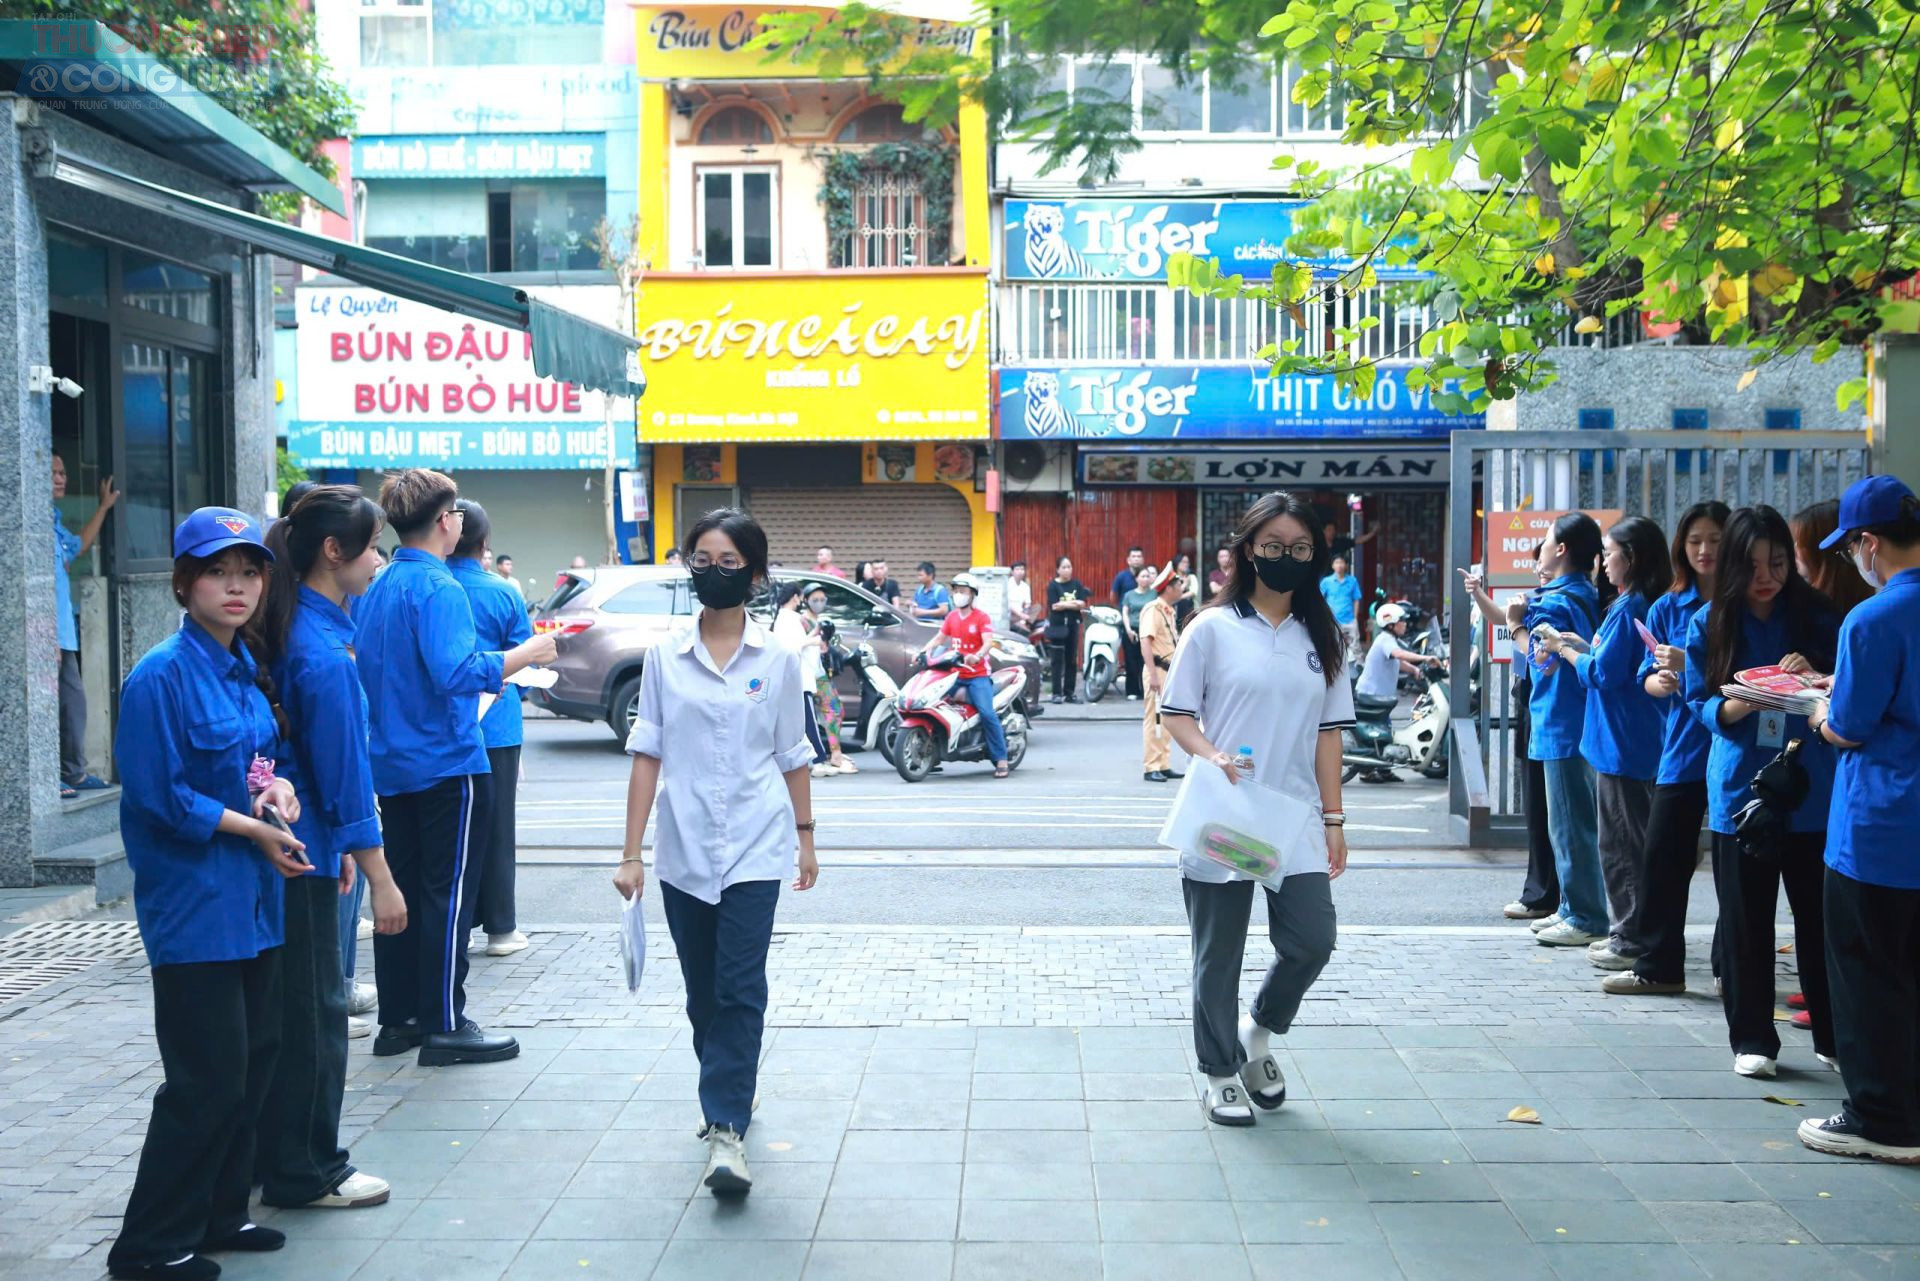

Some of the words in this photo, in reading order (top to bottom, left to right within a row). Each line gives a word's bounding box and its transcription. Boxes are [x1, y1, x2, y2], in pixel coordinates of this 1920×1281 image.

[650, 11, 710, 49] Bún
[1074, 203, 1219, 276] Tiger
[340, 296, 398, 317] Quyên
[331, 323, 412, 362] BÚN
[425, 323, 508, 370] ĐẬU
[355, 376, 429, 413] BÚN
[443, 374, 496, 413] BÒ
[1067, 369, 1197, 435] Tiger
[1253, 377, 1323, 417] THỊT
[320, 425, 364, 455] BÚN
[369, 425, 411, 460] ĐẬU
[418, 431, 462, 460] MẸT
[482, 425, 525, 455] BÚN
[531, 426, 560, 455] BÒ
[1205, 457, 1306, 483] LỢN
[1322, 455, 1437, 479] MÁN
[1222, 1087, 1237, 1103] G
